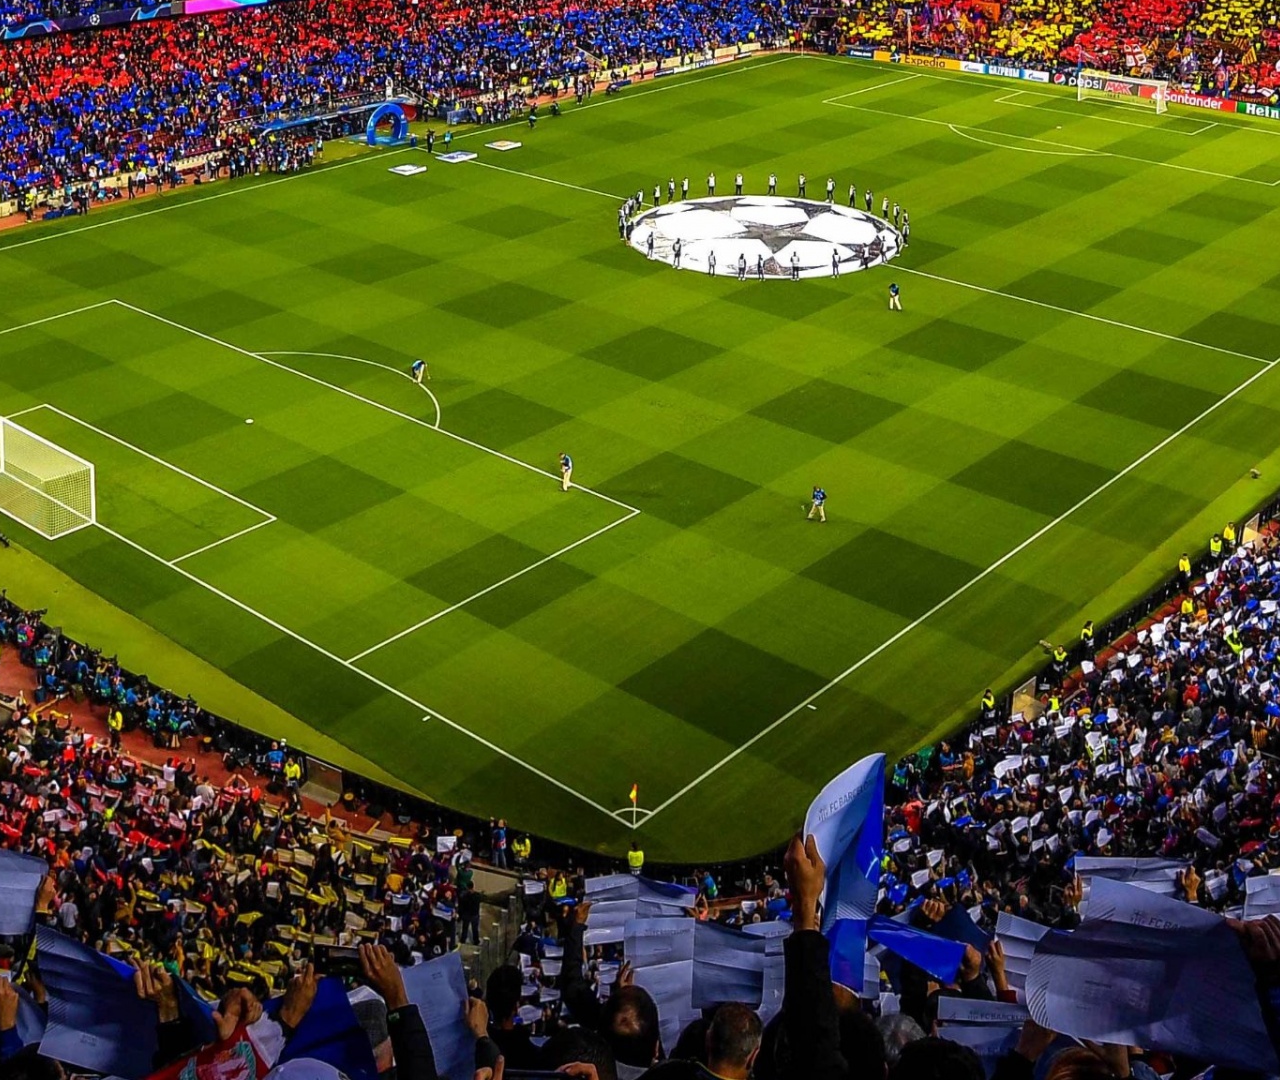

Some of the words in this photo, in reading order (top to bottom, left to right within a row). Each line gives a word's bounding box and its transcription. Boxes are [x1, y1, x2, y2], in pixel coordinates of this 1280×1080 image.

[904, 54, 946, 69] Expedia
[1068, 76, 1103, 90] pepsi
[1104, 80, 1134, 95] MAX
[1163, 90, 1222, 110] Santander
[1149, 917, 1162, 929] FC
